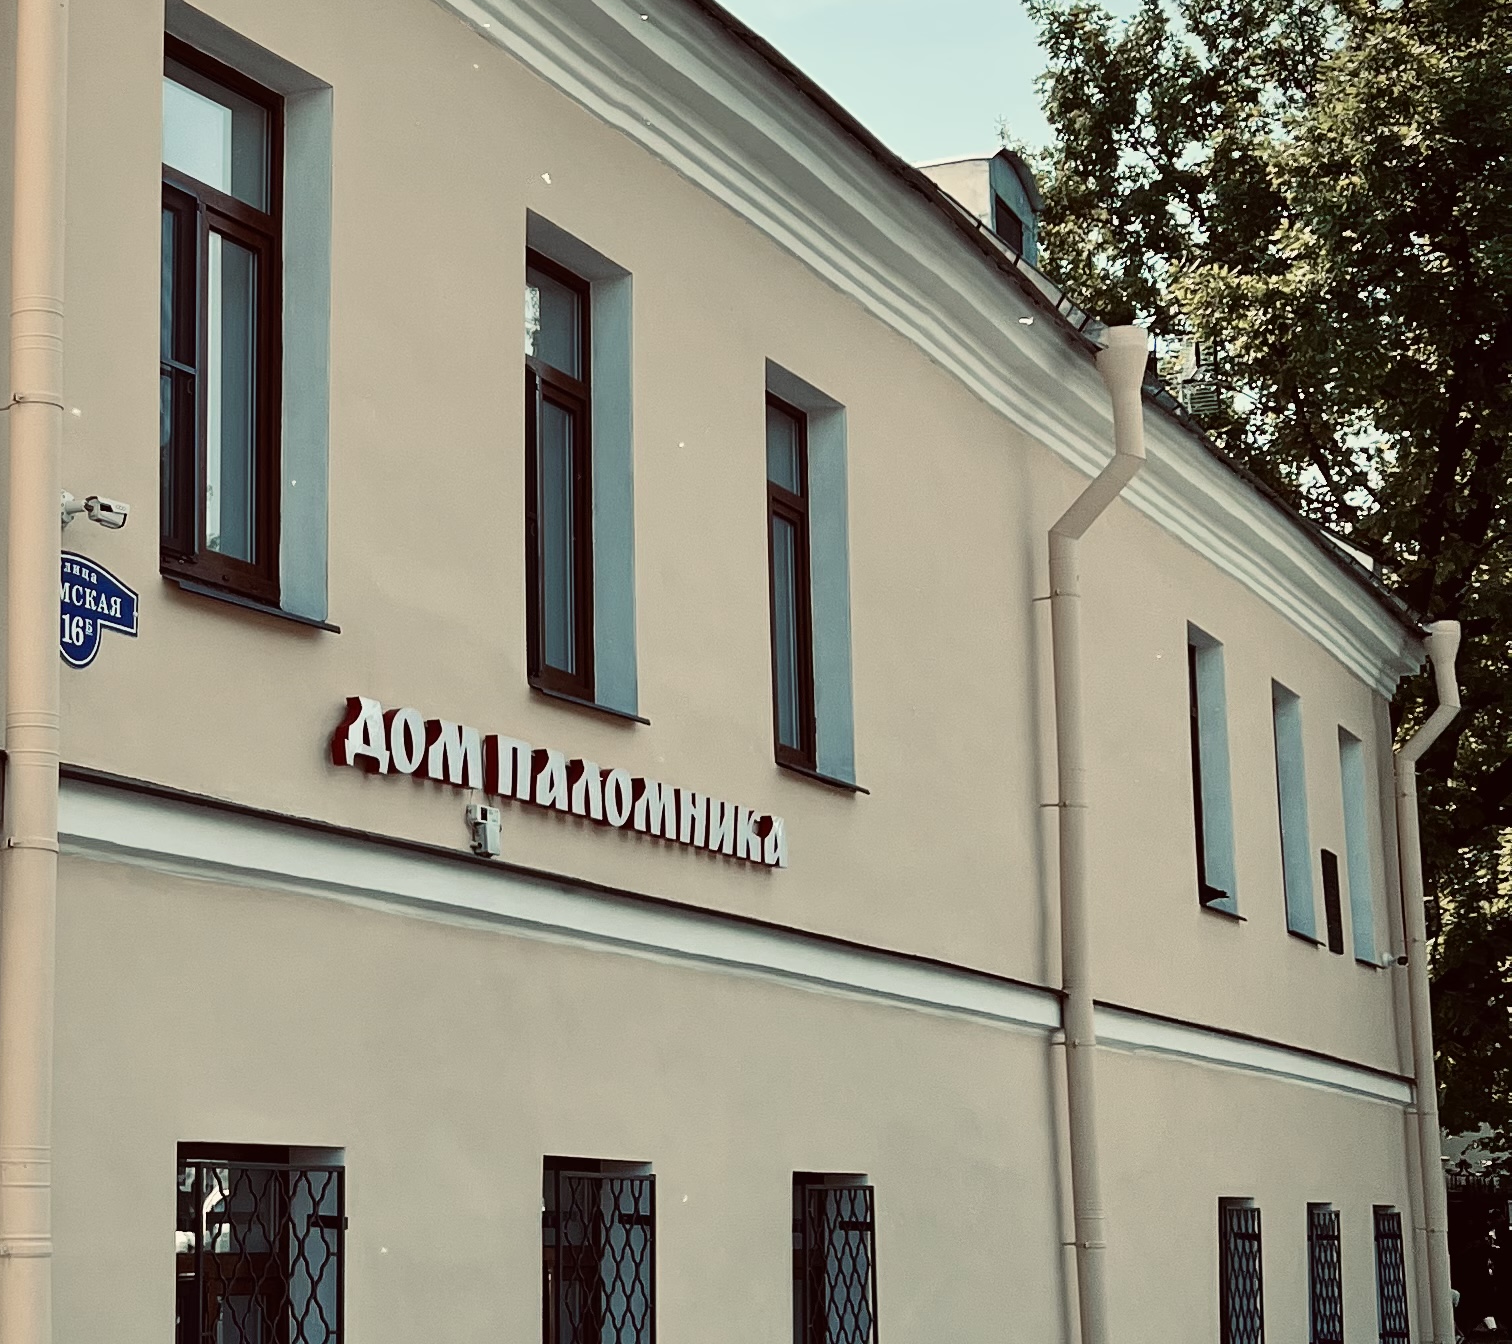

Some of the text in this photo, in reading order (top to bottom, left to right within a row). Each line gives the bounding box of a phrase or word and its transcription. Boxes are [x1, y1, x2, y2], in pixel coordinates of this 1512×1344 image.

[61, 561, 98, 585] лица
[60, 582, 122, 618] МСКАЯ
[334, 695, 789, 868] ДОМ ПАЛОМНИКА
